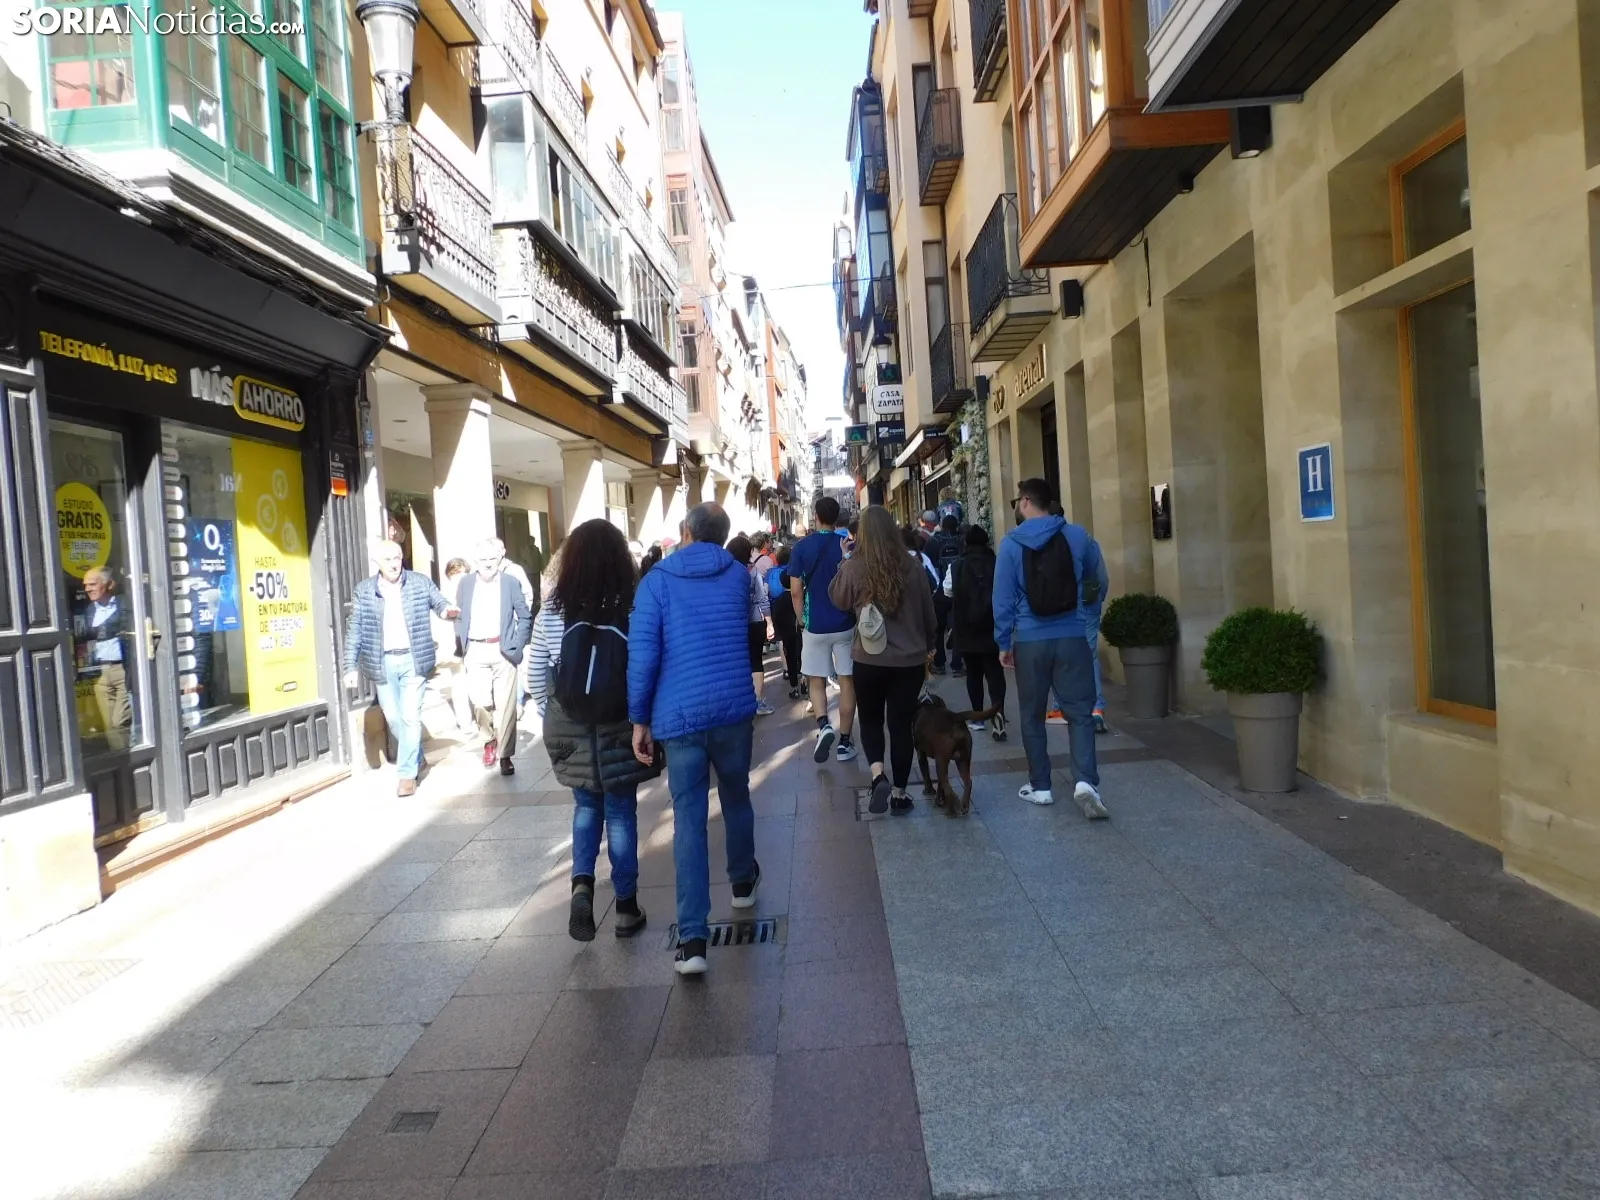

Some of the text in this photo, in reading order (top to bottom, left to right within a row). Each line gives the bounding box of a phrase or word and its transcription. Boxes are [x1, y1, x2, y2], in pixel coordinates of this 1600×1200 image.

[118, 353, 144, 375] LUZ
[153, 363, 177, 384] GAS
[190, 365, 304, 423] MÁS AHORRO
[880, 390, 900, 398] CASA
[1306, 455, 1324, 492] H
[63, 498, 94, 511] ESTUDIO
[57, 510, 103, 530] GRATIS
[254, 556, 277, 568] HASTA
[249, 571, 289, 600] -50%
[258, 602, 308, 616] EN TU FACTURA
[259, 621, 269, 633] DE
